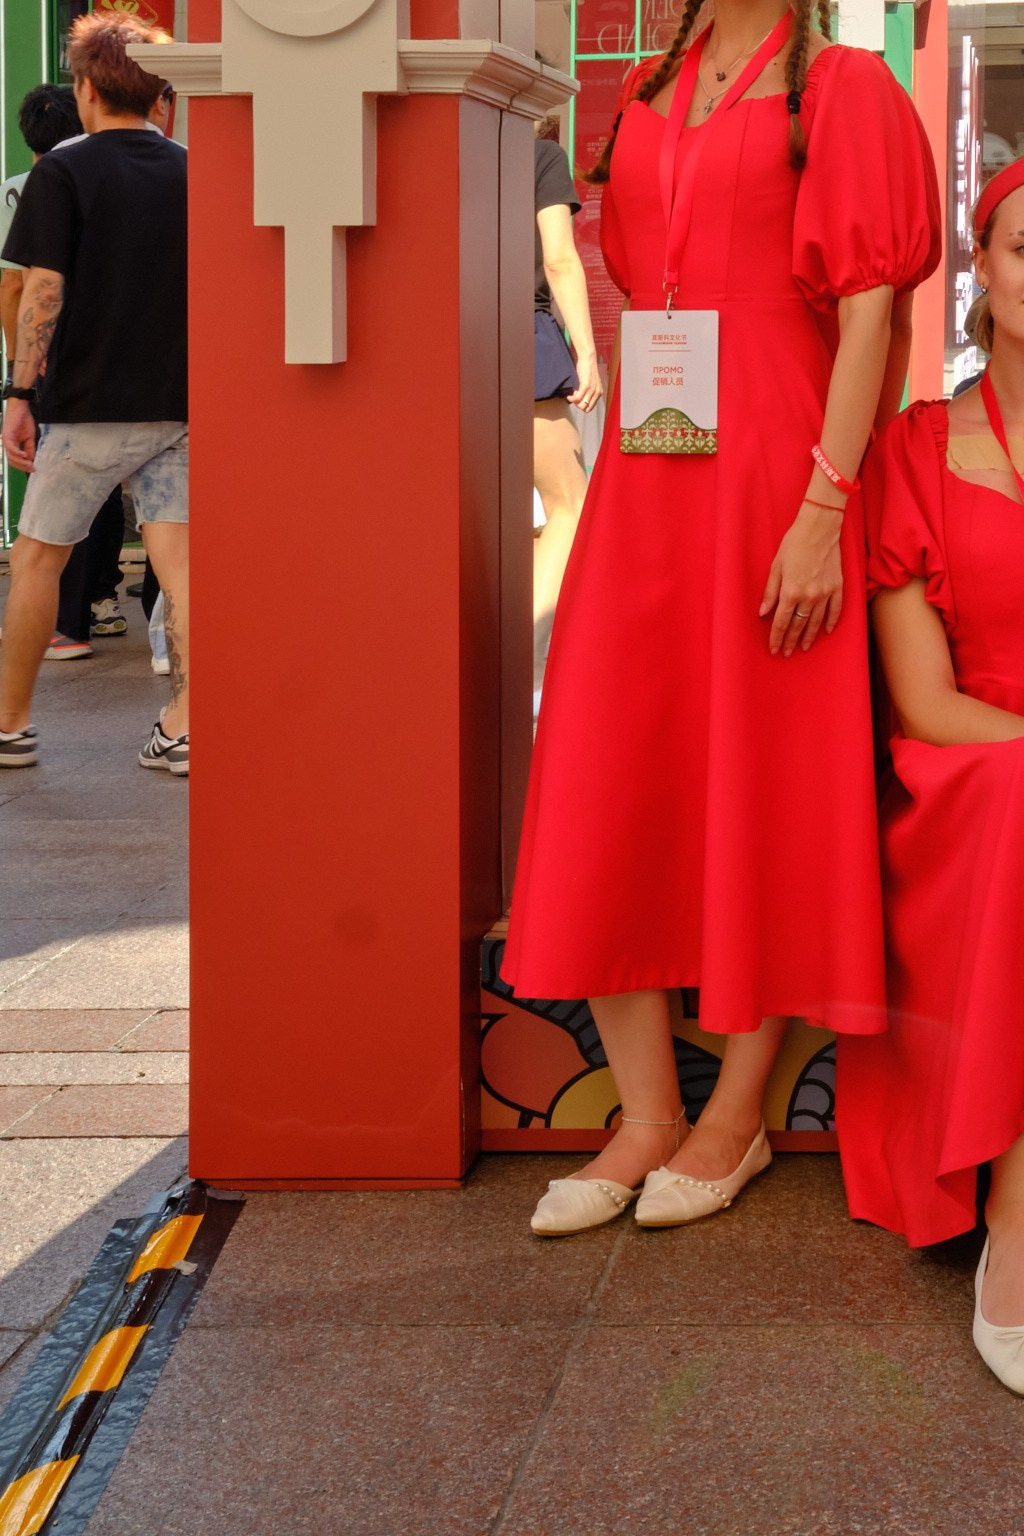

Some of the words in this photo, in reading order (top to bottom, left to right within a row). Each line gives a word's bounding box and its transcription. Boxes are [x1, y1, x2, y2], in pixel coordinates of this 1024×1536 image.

[652, 366, 684, 374] ПРОМО
[652, 377, 684, 386] 促销人员
